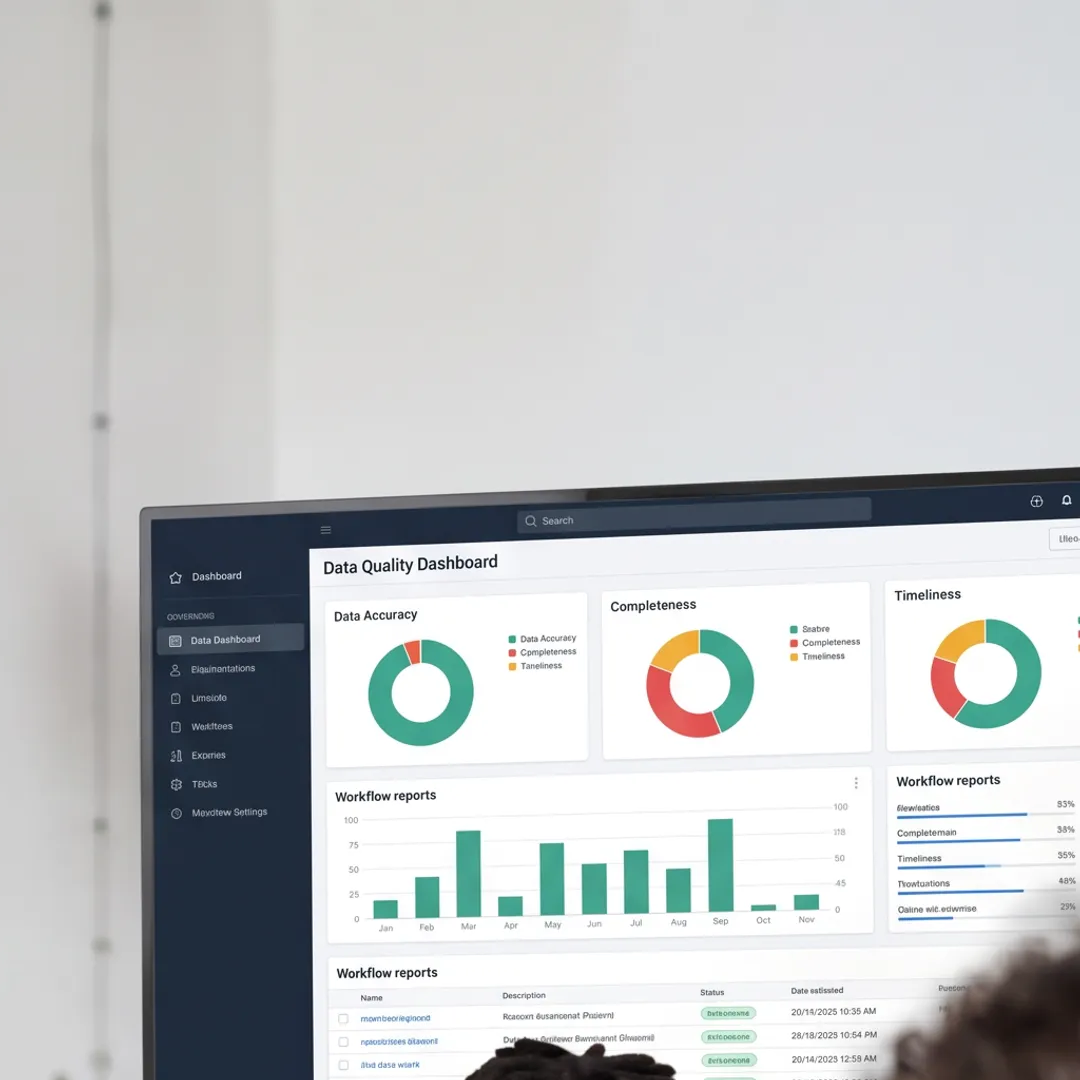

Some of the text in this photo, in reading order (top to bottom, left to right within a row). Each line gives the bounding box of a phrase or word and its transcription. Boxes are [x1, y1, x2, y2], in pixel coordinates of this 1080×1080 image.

[542, 515, 574, 526] Search
[323, 554, 499, 576] Data Quality Dashboard
[192, 571, 243, 582] Dashboard
[894, 589, 962, 602] Timeliness
[610, 599, 697, 614] Completeness
[333, 609, 418, 623] Data Accuracy
[191, 634, 261, 645] Data Dashboard
[520, 634, 539, 643] Data
[802, 637, 861, 648] Completeness
[896, 774, 1001, 788] Workflow reports
[335, 790, 437, 804] Workflow reports
[833, 803, 849, 811] 100
[233, 807, 268, 819] Settings
[344, 816, 359, 825] 100
[349, 841, 360, 849] 75
[834, 854, 846, 863] 50
[897, 854, 943, 863] Timeliness
[348, 866, 360, 874] 50
[349, 890, 360, 899] 25
[834, 905, 841, 914] 0
[354, 915, 360, 924] 0
[378, 915, 816, 933] Jan Feb Mar Apr May Jun Jul Aug Sep Oct Nov
[336, 966, 438, 980] Workflow reports
[700, 988, 725, 997] Status
[791, 987, 809, 995] Date
[360, 994, 384, 1002] Name
[502, 991, 547, 1001] Description
[840, 1007, 862, 1016] 10:35
[863, 1007, 877, 1016] AM
[864, 1031, 878, 1039] PM
[863, 1054, 877, 1063] AM
